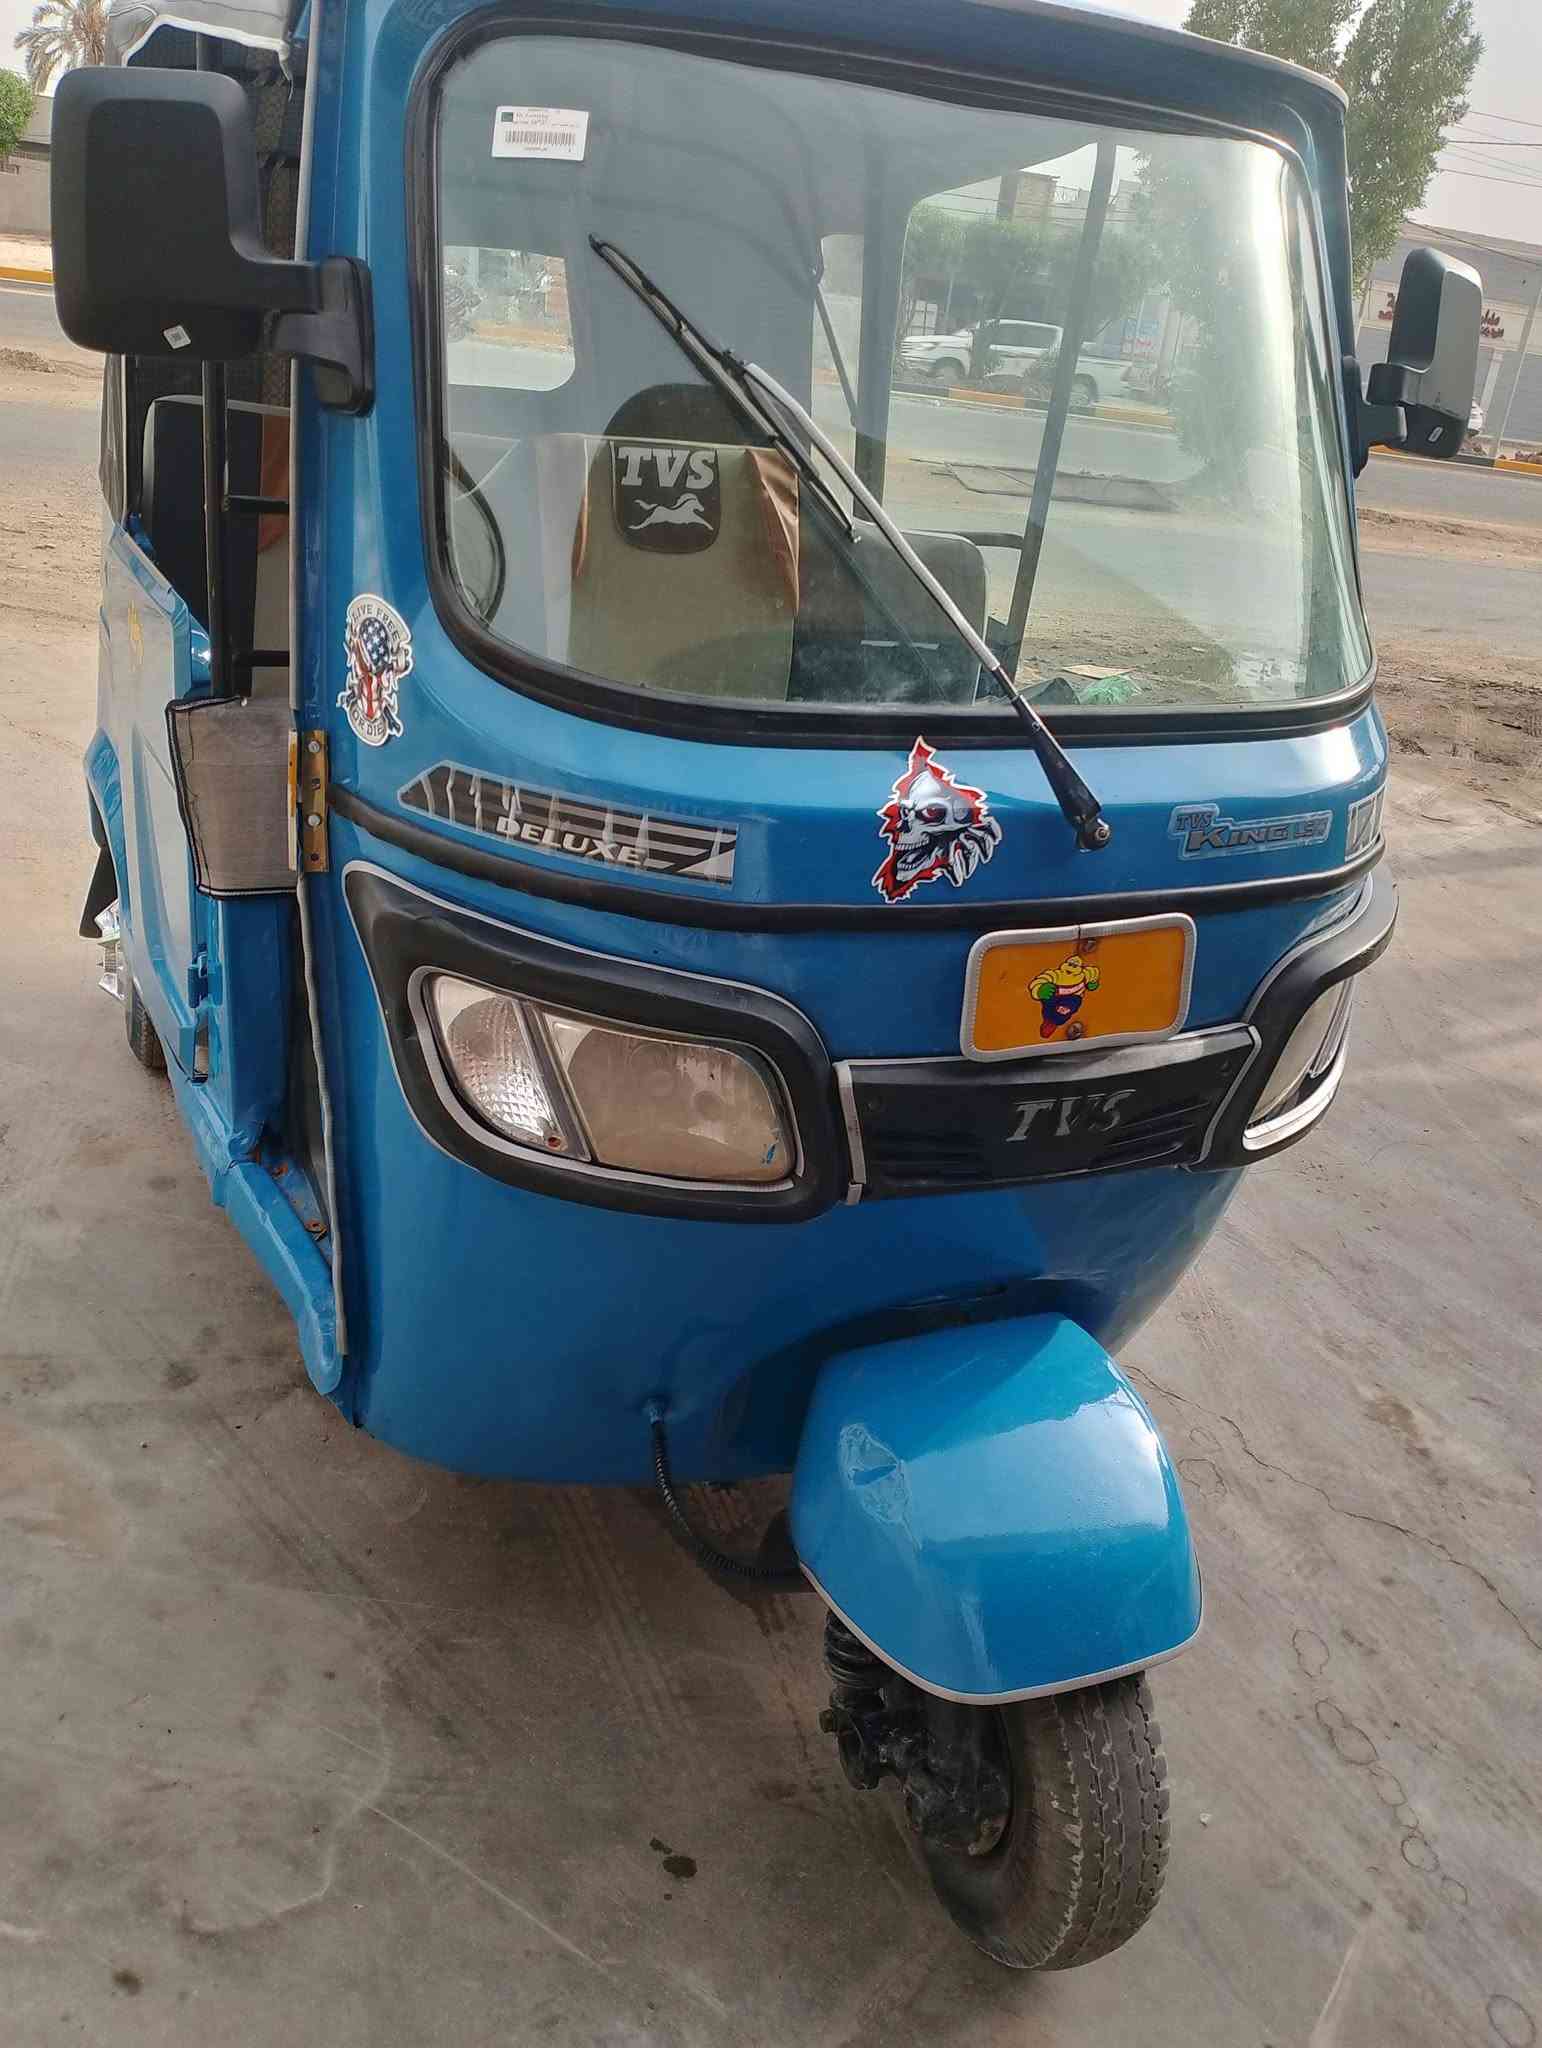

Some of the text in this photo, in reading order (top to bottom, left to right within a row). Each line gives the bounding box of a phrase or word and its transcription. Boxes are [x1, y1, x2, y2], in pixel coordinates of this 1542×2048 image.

[617, 446, 716, 490] TVS
[352, 604, 401, 643] LIVE FREE
[351, 709, 385, 737] OR DIE
[495, 815, 648, 866] DELUXE
[1005, 1088, 1137, 1143] TVS
